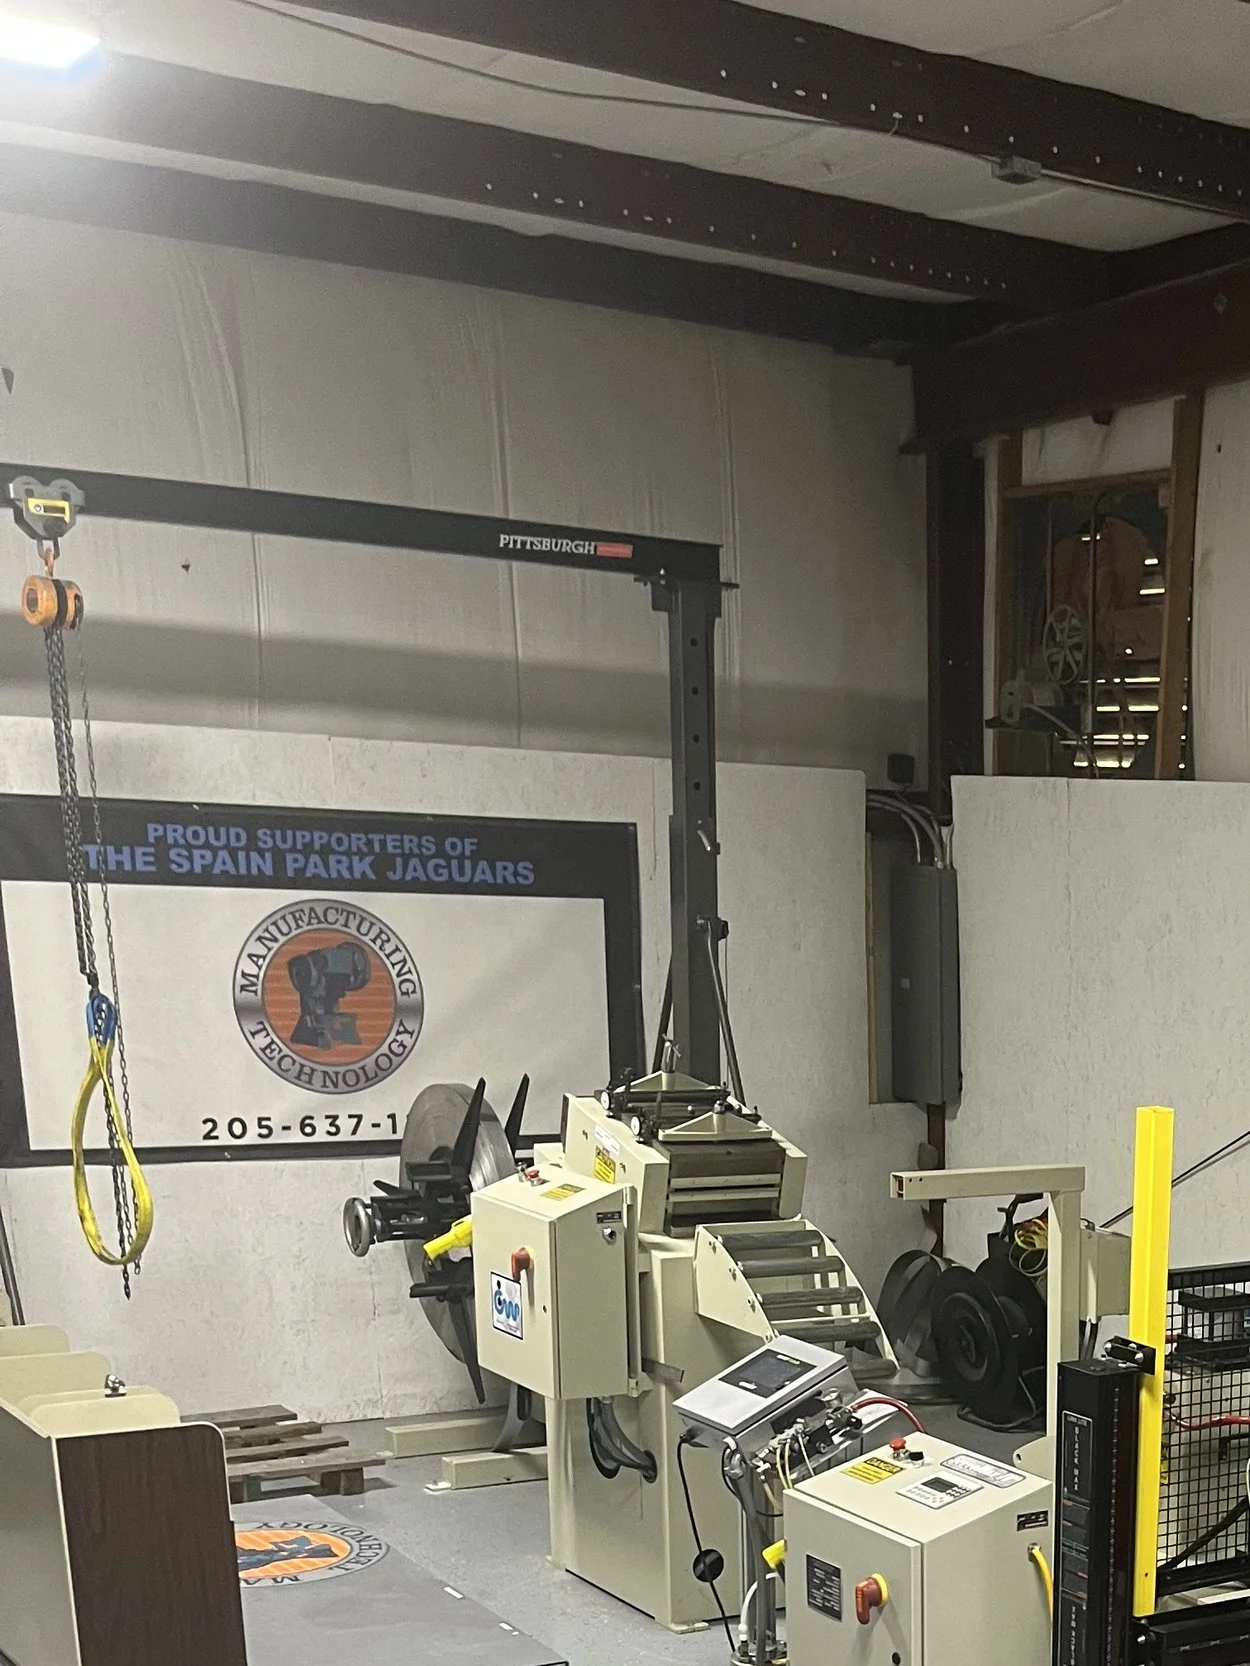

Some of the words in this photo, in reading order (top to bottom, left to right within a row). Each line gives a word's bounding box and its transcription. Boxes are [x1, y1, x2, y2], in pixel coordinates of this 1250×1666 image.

[500, 534, 595, 554] PITTSBURGH
[146, 823, 247, 847] PROUD
[257, 829, 436, 856] SUPPORTERS
[444, 836, 478, 857] OF
[83, 843, 156, 872] THE
[168, 847, 273, 877] SPAIN
[286, 852, 376, 881] PARK
[386, 856, 535, 885] JAGUARS
[239, 905, 418, 999] MANUFACTURING
[249, 1019, 416, 1089] TECHNOLOGY
[256, 1521, 383, 1572] TECHNOLOGY
